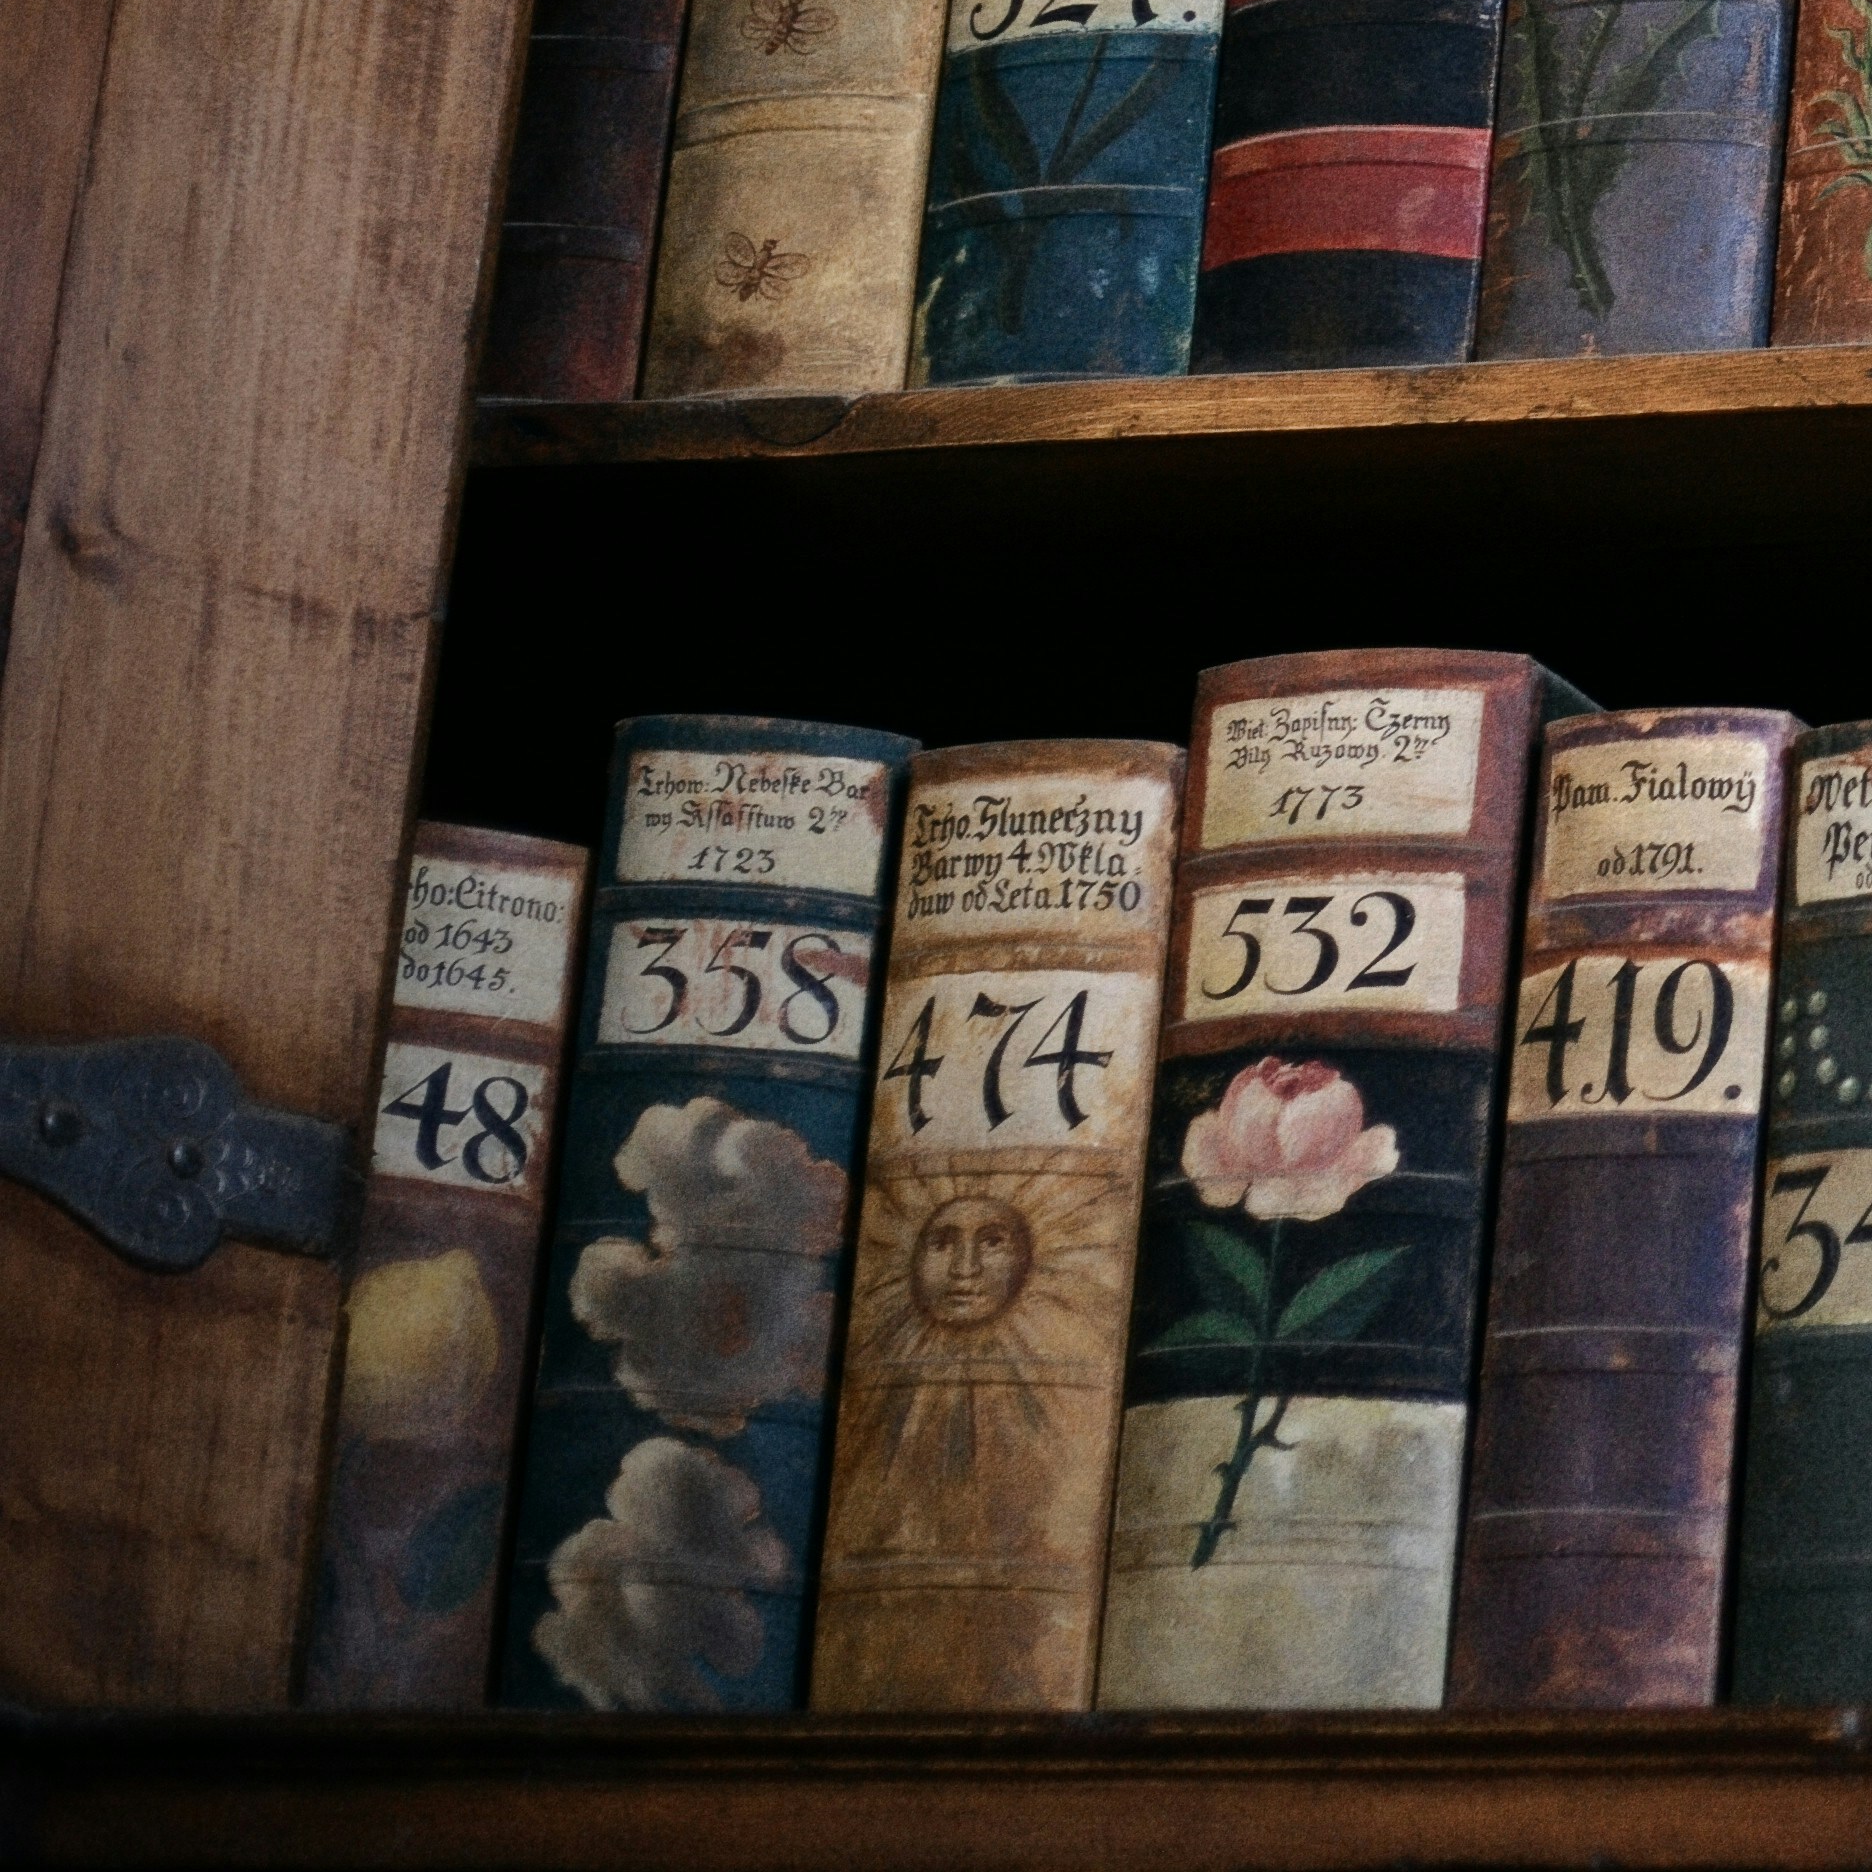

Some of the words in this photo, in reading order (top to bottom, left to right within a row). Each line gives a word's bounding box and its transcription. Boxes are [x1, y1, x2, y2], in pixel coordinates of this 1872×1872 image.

[1268, 783, 1366, 826] 1773
[688, 846, 777, 876] 1723
[1051, 877, 1143, 912] 1750
[1627, 840, 1704, 877] 1791.
[439, 919, 514, 955] 1643
[1200, 890, 1419, 1002] 532
[621, 925, 842, 1046] 358
[884, 989, 1115, 1137] 474
[1519, 959, 1743, 1107] 419.
[382, 1061, 529, 1184] 48
